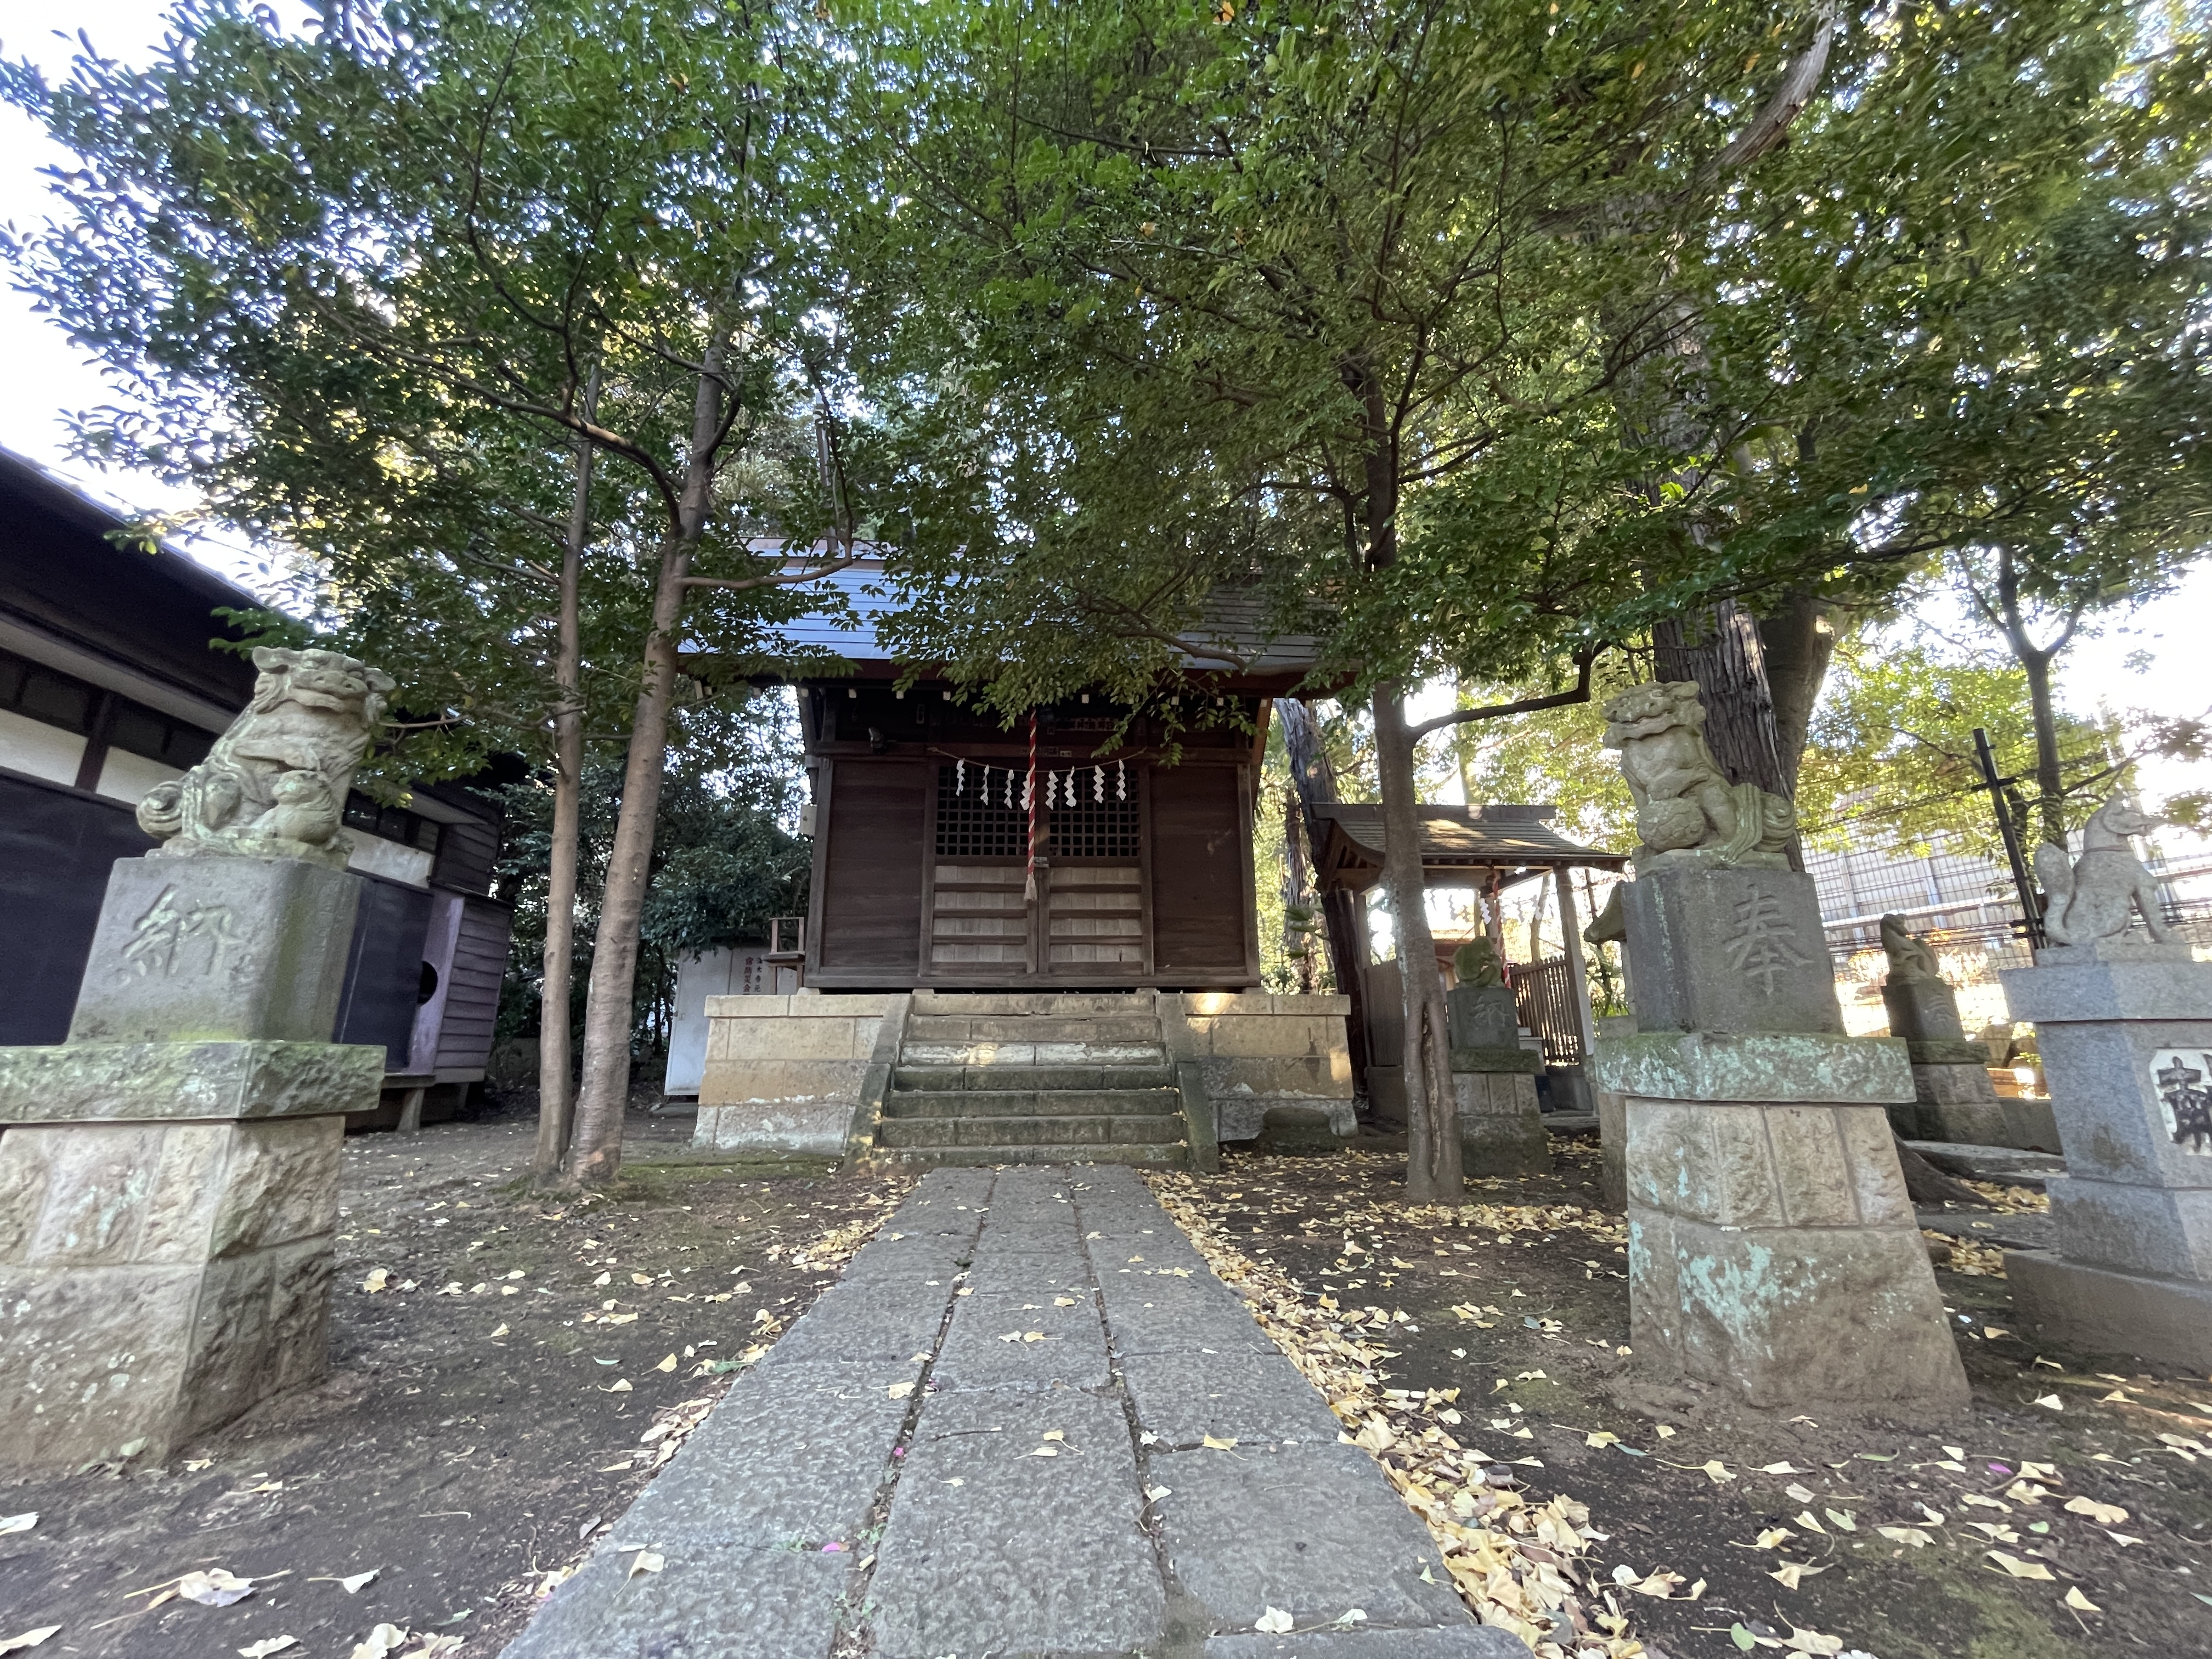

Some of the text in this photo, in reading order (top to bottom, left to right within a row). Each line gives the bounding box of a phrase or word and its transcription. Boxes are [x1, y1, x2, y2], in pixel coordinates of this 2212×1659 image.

[107, 883, 245, 986] 納
[1722, 884, 1815, 995] 奉
[1469, 994, 1510, 1030] 納
